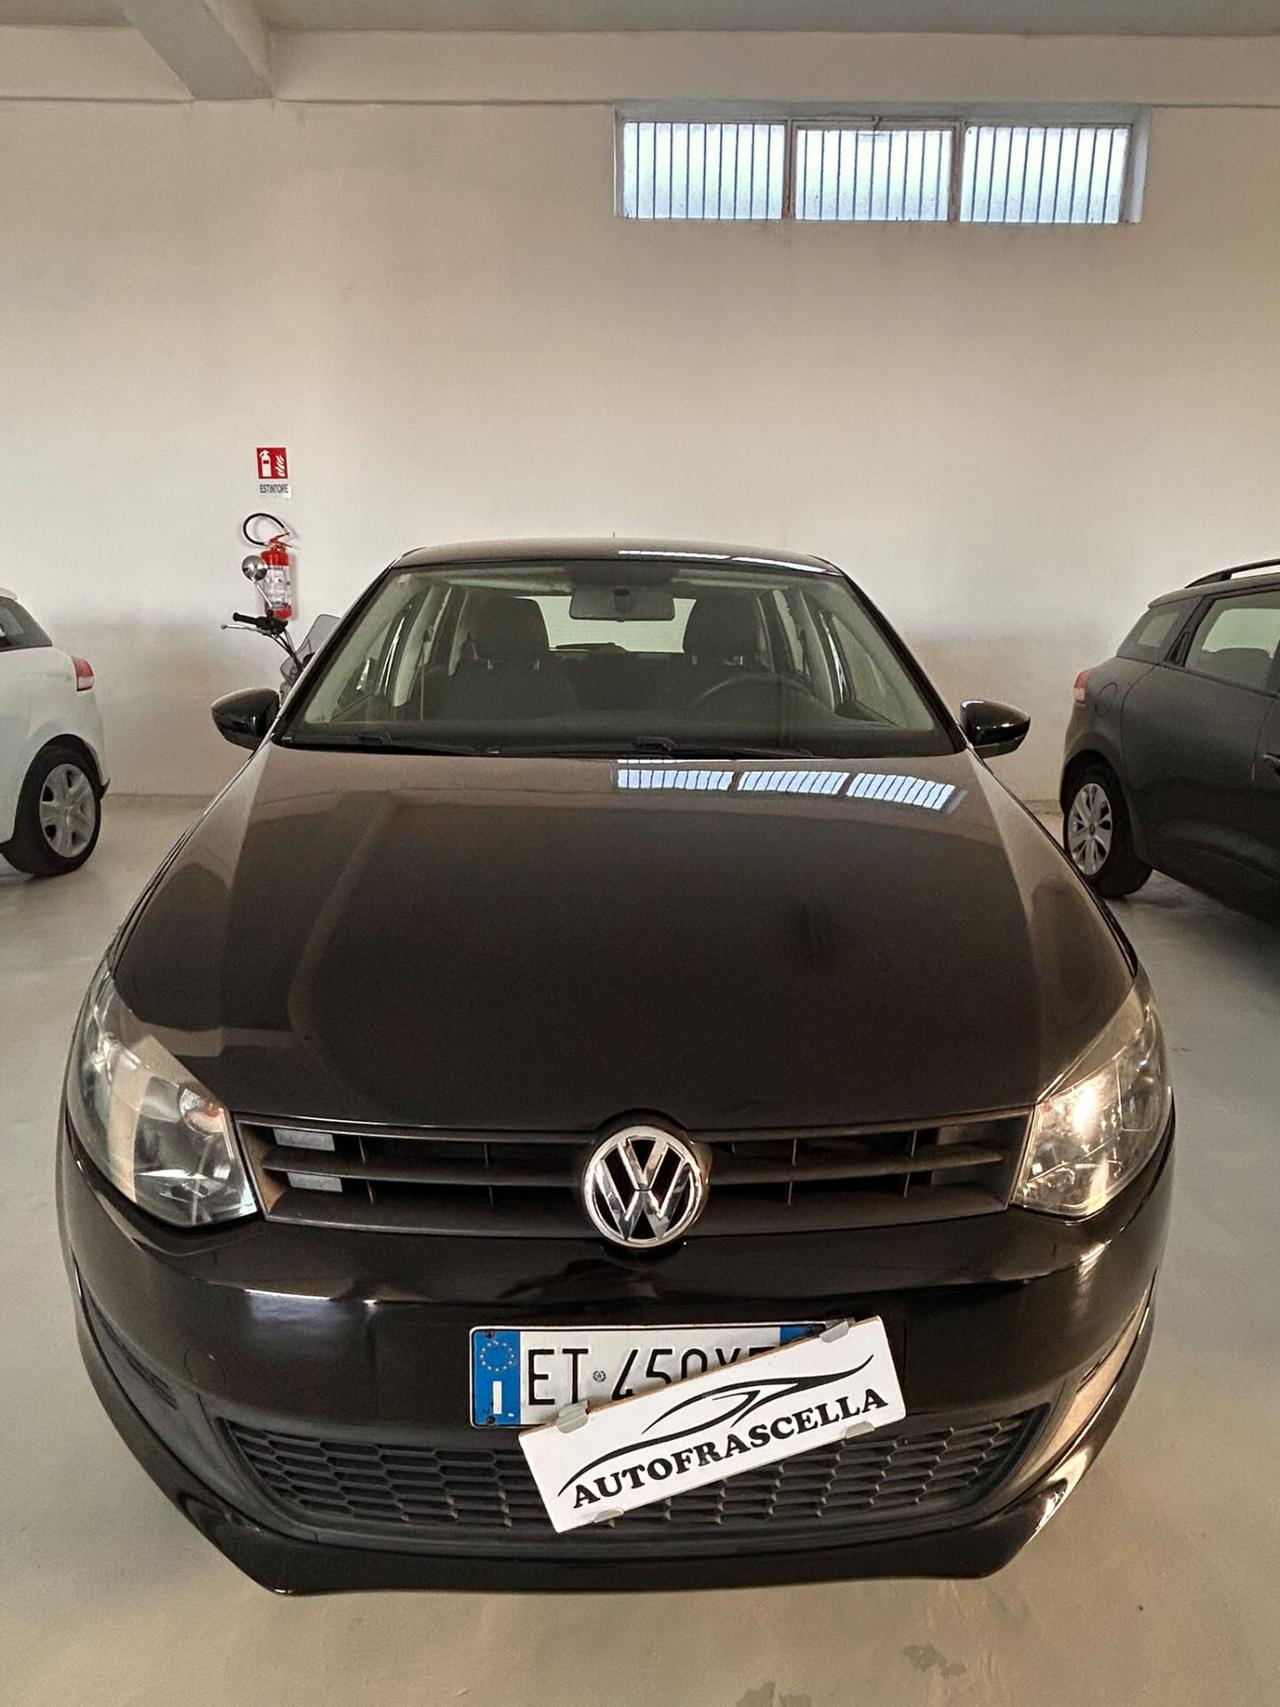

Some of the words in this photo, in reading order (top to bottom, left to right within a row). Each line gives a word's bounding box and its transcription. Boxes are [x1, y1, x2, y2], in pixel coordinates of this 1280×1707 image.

[260, 484, 289, 494] ESTINTORE
[590, 1134, 694, 1241] VW
[528, 1348, 589, 1406] ET
[611, 1346, 776, 1400] 450
[573, 1388, 888, 1508] AUTOFRASCELLA
